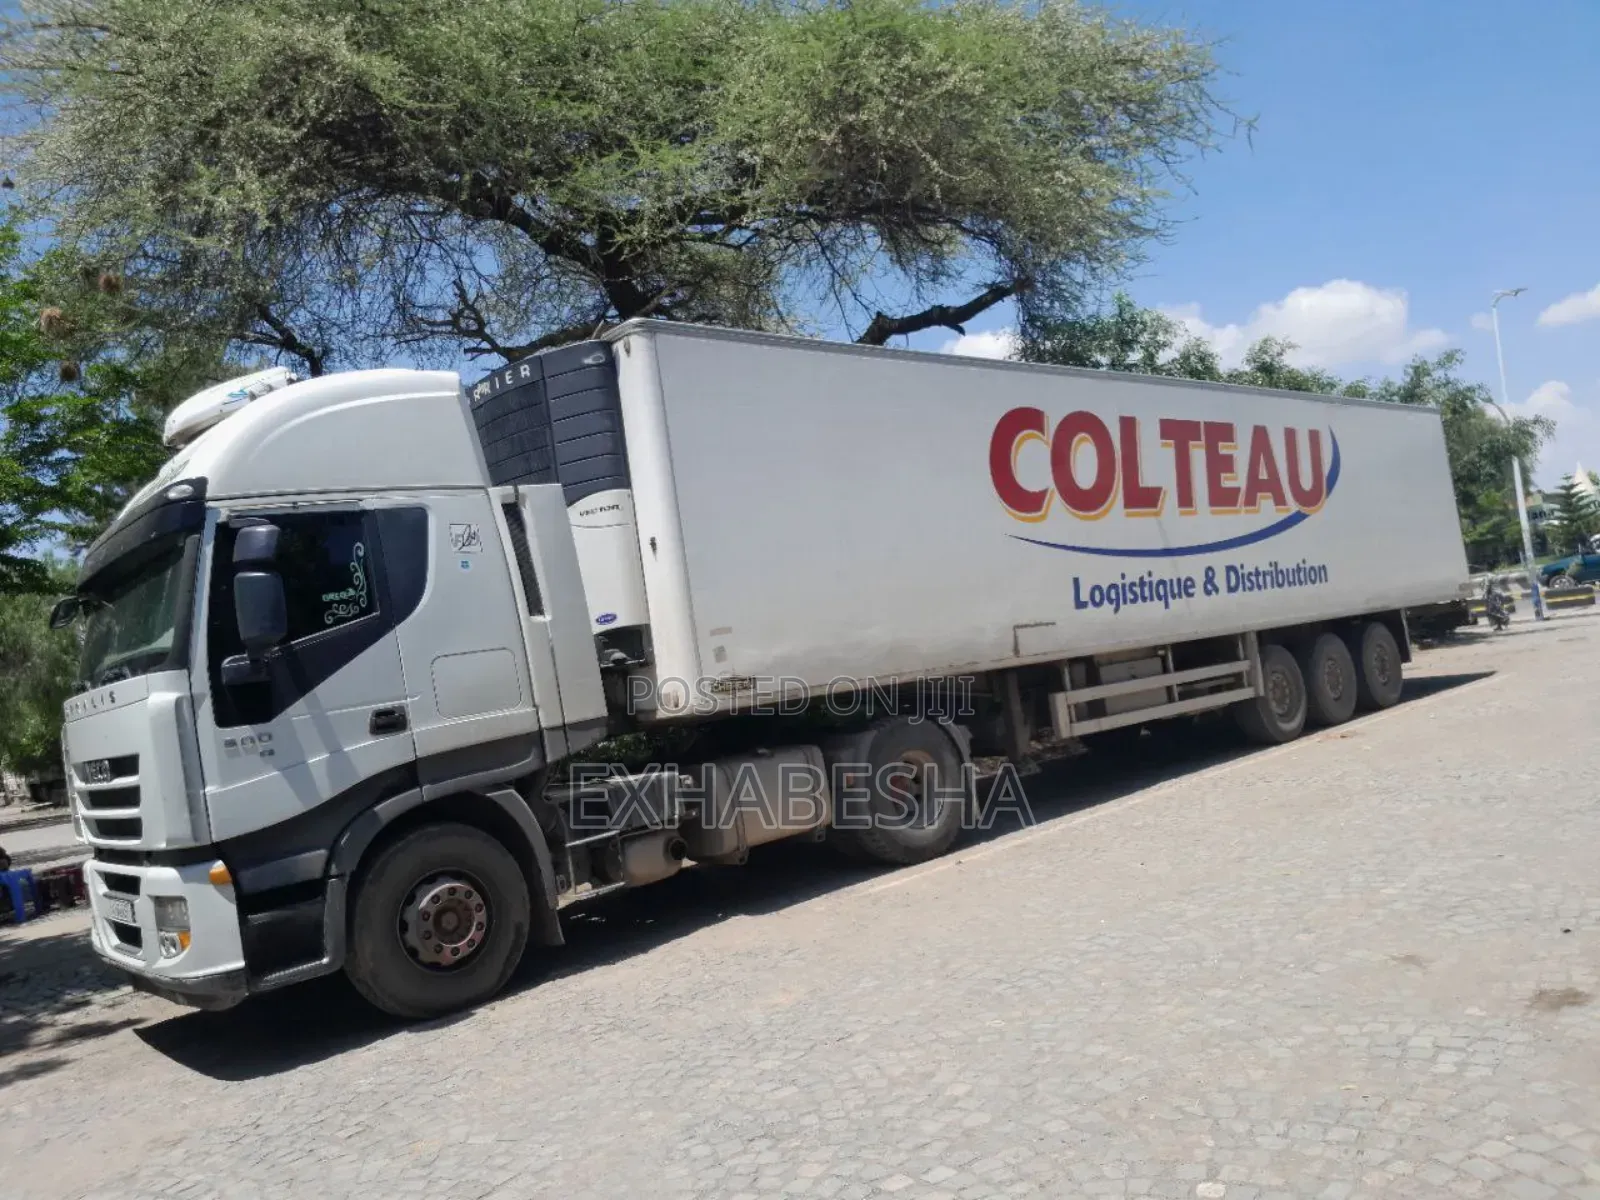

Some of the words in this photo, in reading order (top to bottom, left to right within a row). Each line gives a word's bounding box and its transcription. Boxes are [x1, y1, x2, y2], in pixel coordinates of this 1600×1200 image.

[989, 406, 1328, 522] COLTEAU
[1072, 571, 1196, 614] Logistique
[1203, 565, 1220, 596] &
[1225, 558, 1328, 594] Distribution
